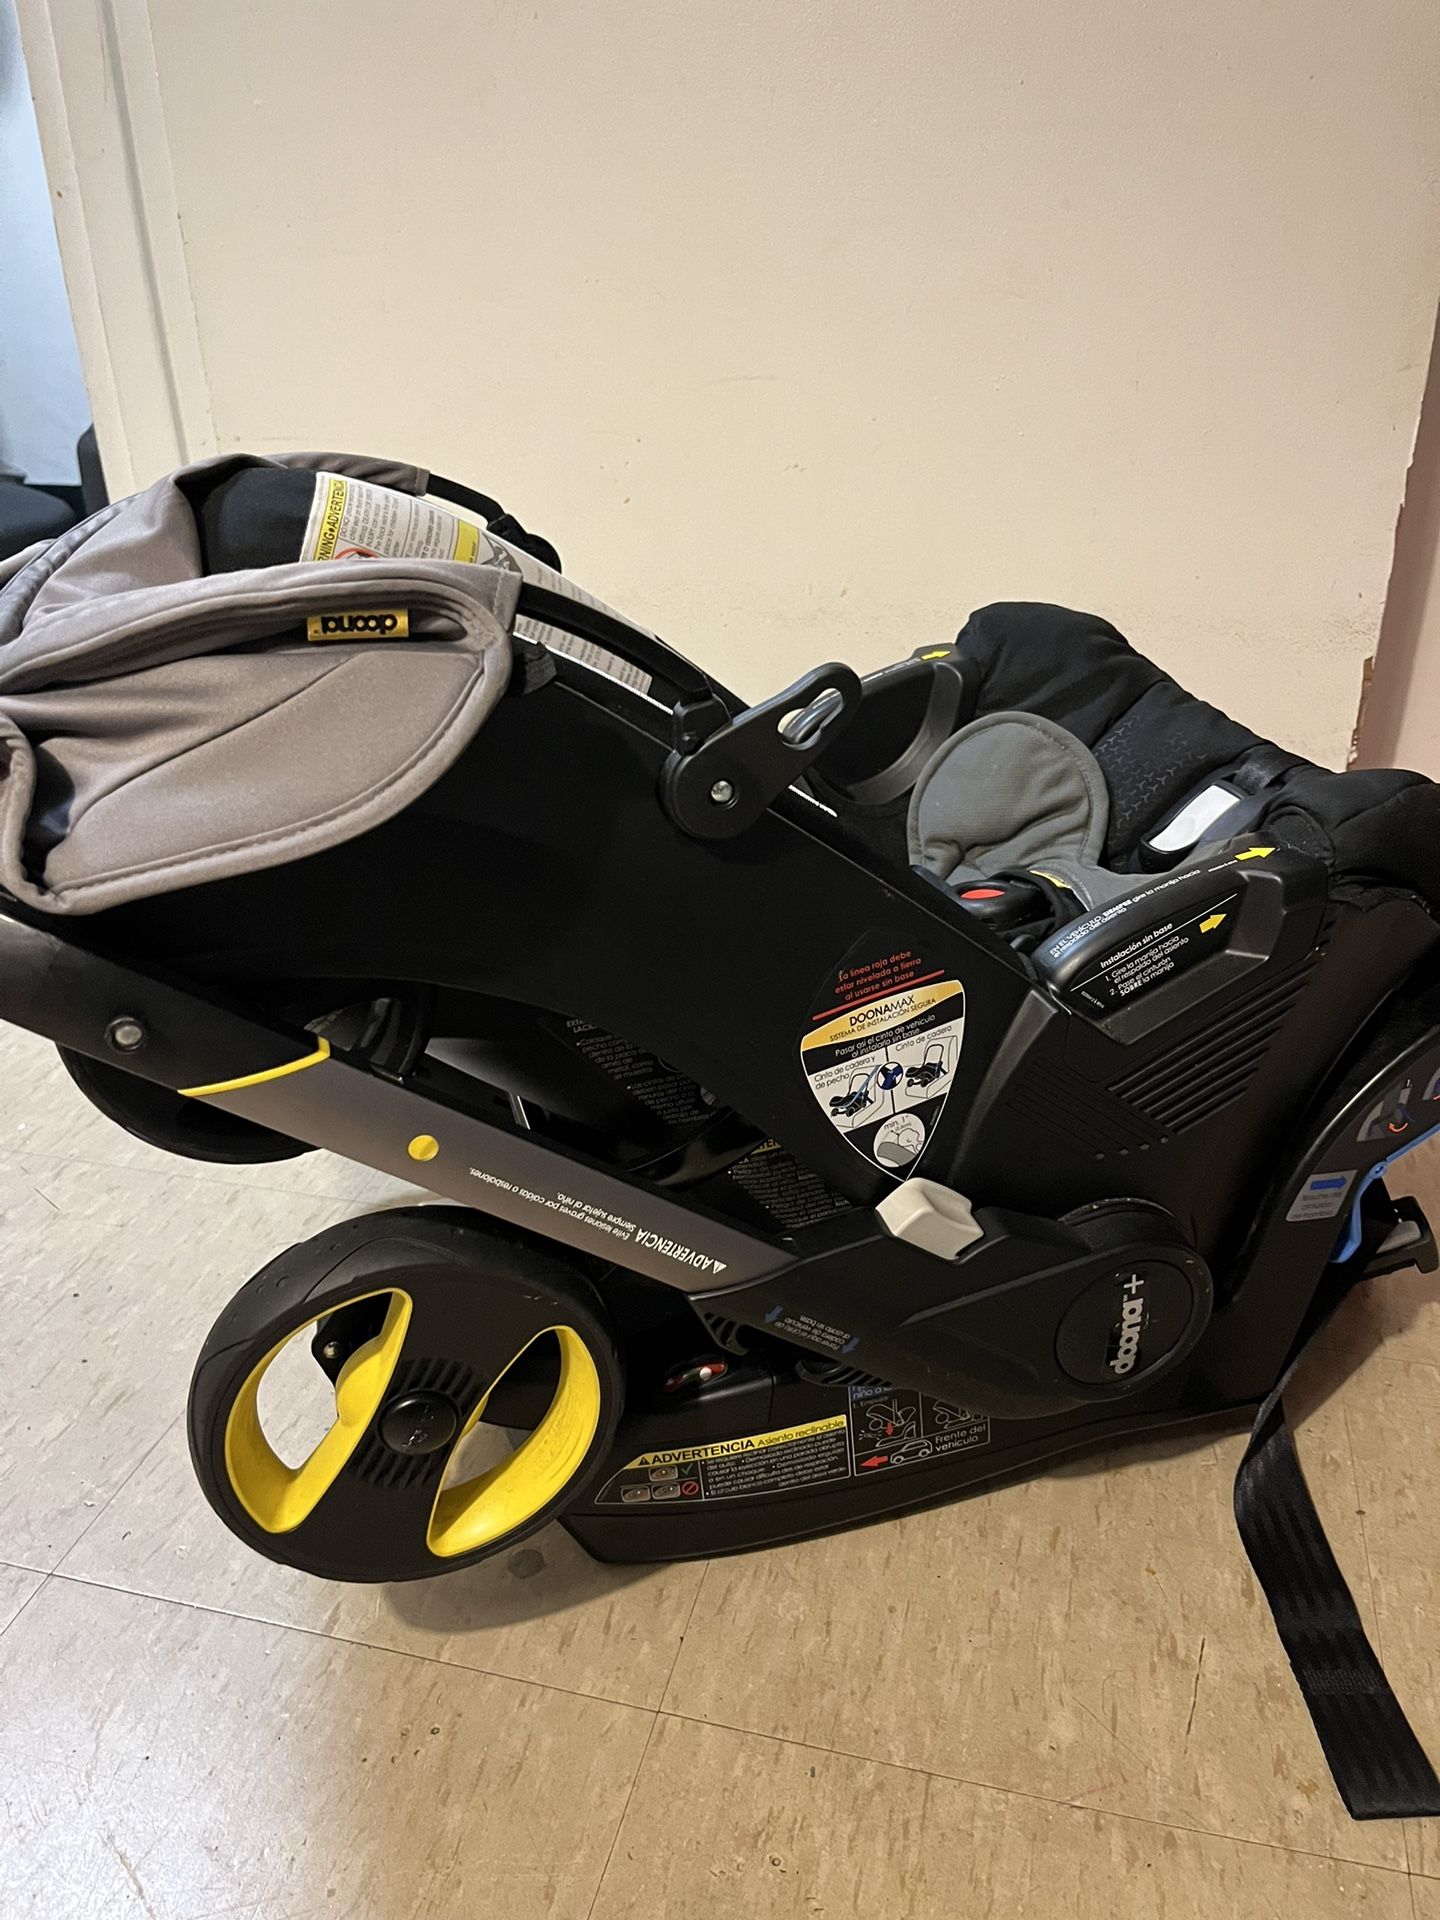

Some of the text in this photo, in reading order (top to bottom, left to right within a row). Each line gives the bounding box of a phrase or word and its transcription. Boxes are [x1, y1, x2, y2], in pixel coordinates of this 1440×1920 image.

[321, 614, 398, 635] doona
[889, 950, 912, 963] debe
[1100, 923, 1173, 969] Instalación sin base
[1111, 965, 1127, 978] Gire
[1134, 948, 1159, 966] manija
[1158, 935, 1180, 950] hacia
[1121, 959, 1152, 980] respaldo
[1152, 950, 1164, 962] del
[1163, 937, 1190, 955] asiento
[835, 981, 855, 994] estar
[856, 968, 891, 985] nivelada
[855, 983, 881, 997] usarse
[881, 978, 893, 987] sin
[894, 971, 915, 982] base
[1118, 978, 1135, 990] Pase
[1119, 981, 1143, 997] SOBRE
[1150, 961, 1175, 979] manija
[830, 1029, 856, 1043] SISTEMA
[856, 1022, 866, 1032] DE
[910, 998, 937, 1012] SEGURA
[849, 994, 915, 1027] DOONAMAX
[835, 1044, 856, 1057] Pasar
[875, 1028, 894, 1043] cinto
[894, 1024, 905, 1035] de
[895, 1025, 953, 1053] Cinto de cadera
[814, 1069, 834, 1083] Cinto
[834, 1066, 845, 1077] de
[845, 1057, 870, 1071] cadera
[816, 1074, 850, 1090] de pecho
[469, 1167, 512, 1190] resbalones.
[545, 1199, 560, 1210] por
[559, 1205, 585, 1220] graves
[582, 1204, 608, 1219] sujetar
[584, 1216, 611, 1233] lesiones
[607, 1214, 637, 1233] Siempre
[612, 1227, 631, 1241] Evite
[635, 1228, 714, 1271] ADVERTENCIA
[652, 1440, 755, 1465] ADVERTENCIA
[758, 1432, 794, 1447] Asiento
[795, 1420, 844, 1437] reclinable
[935, 1423, 987, 1443] Frente del
